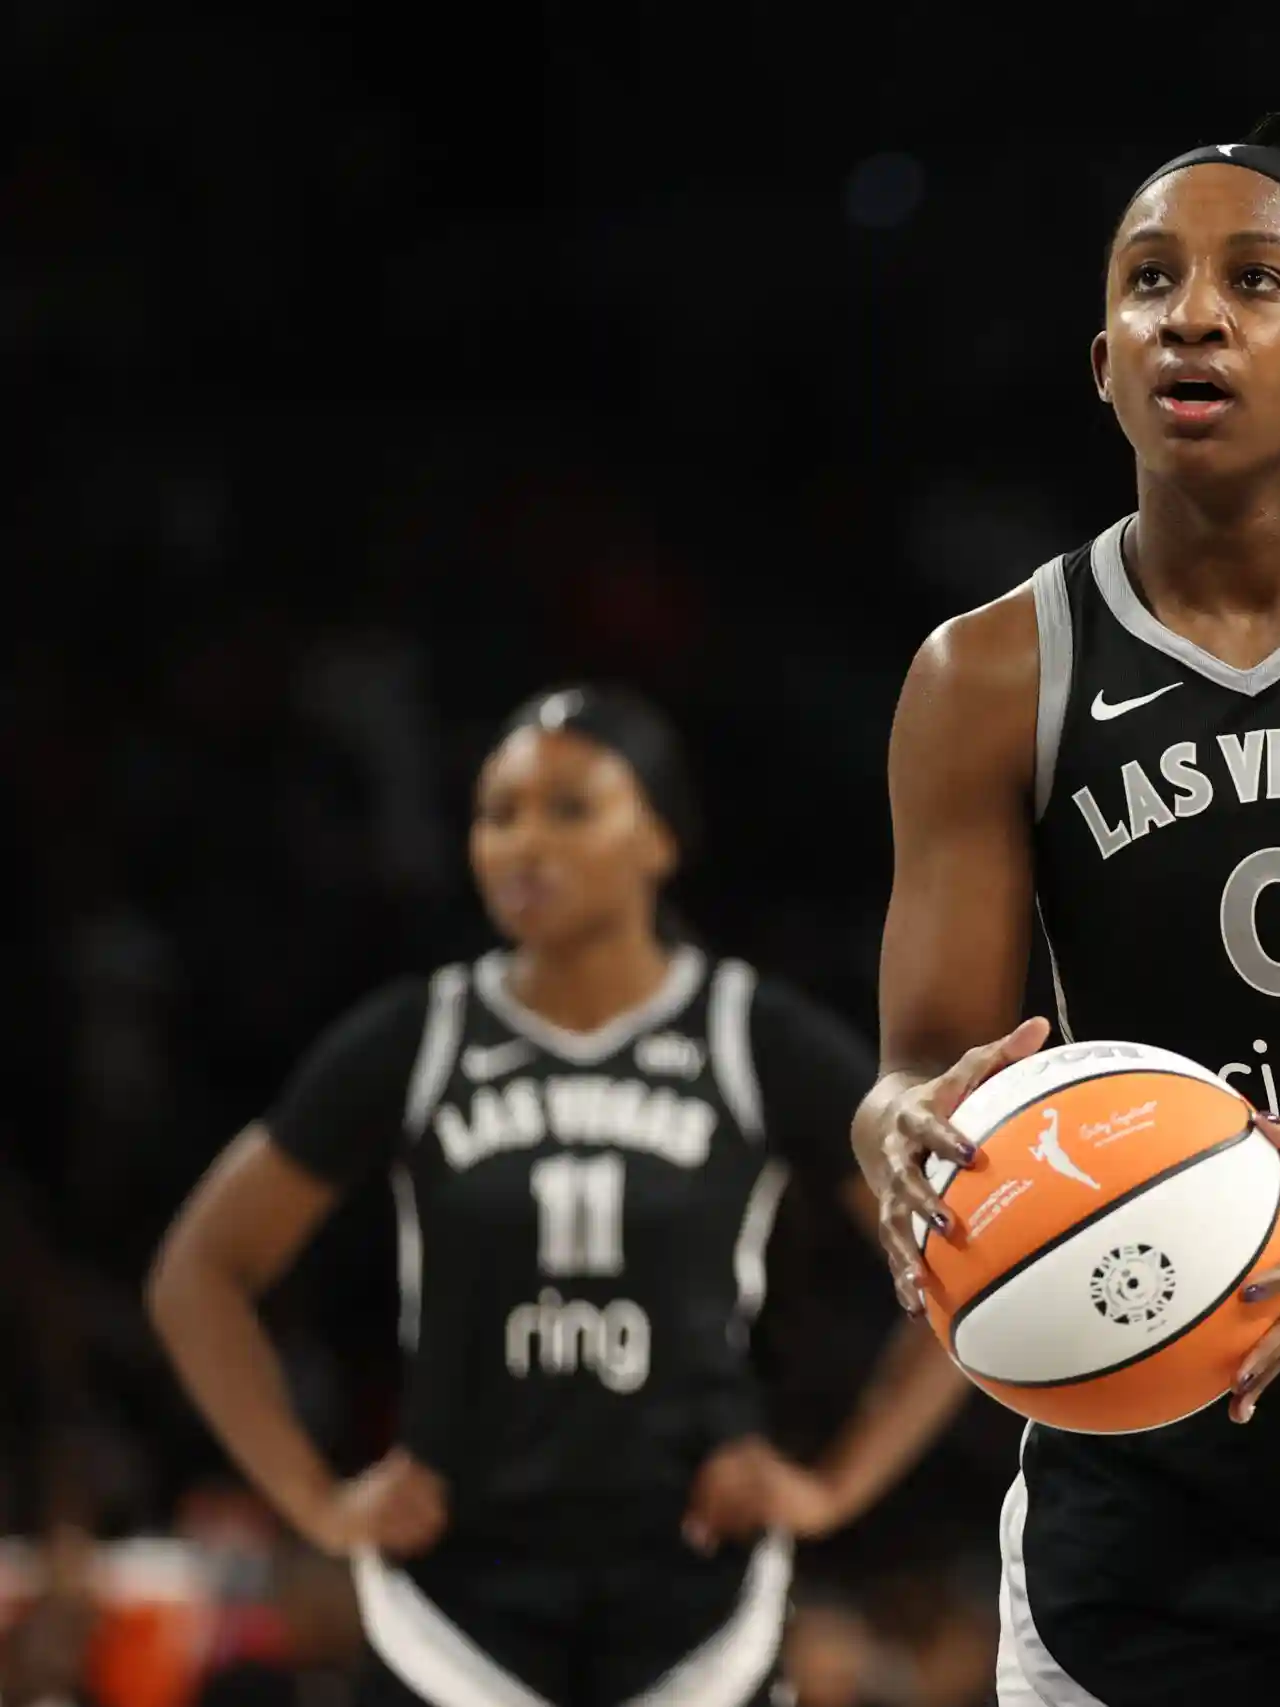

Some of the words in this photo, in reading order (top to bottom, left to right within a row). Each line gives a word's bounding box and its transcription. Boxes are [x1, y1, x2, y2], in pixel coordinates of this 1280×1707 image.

[1072, 742, 1213, 860] LAS
[531, 1153, 625, 1276] 11
[507, 1287, 651, 1393] ring
